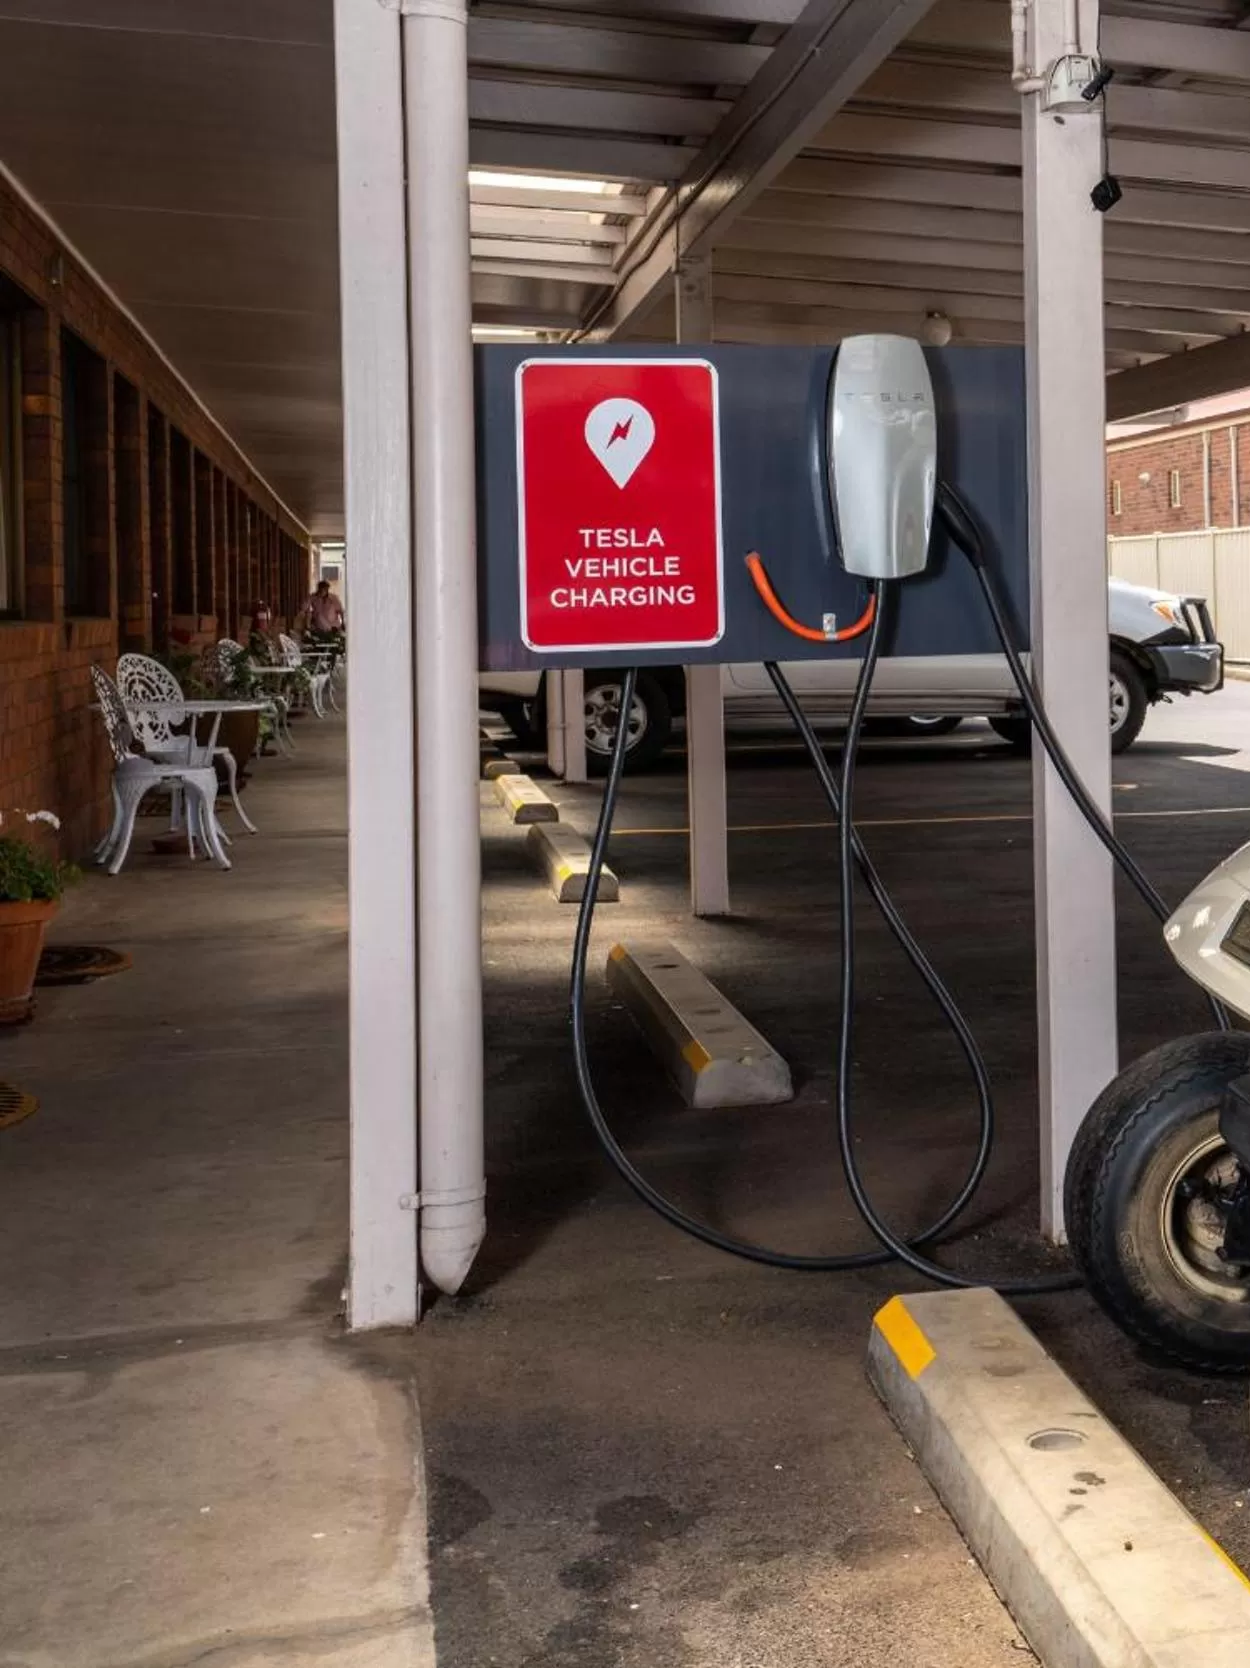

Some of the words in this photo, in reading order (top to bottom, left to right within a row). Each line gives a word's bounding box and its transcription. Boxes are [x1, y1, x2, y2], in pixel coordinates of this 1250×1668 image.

[579, 528, 664, 547] TESLA
[565, 556, 680, 577] VEHICLE
[550, 585, 695, 608] CHARGING
